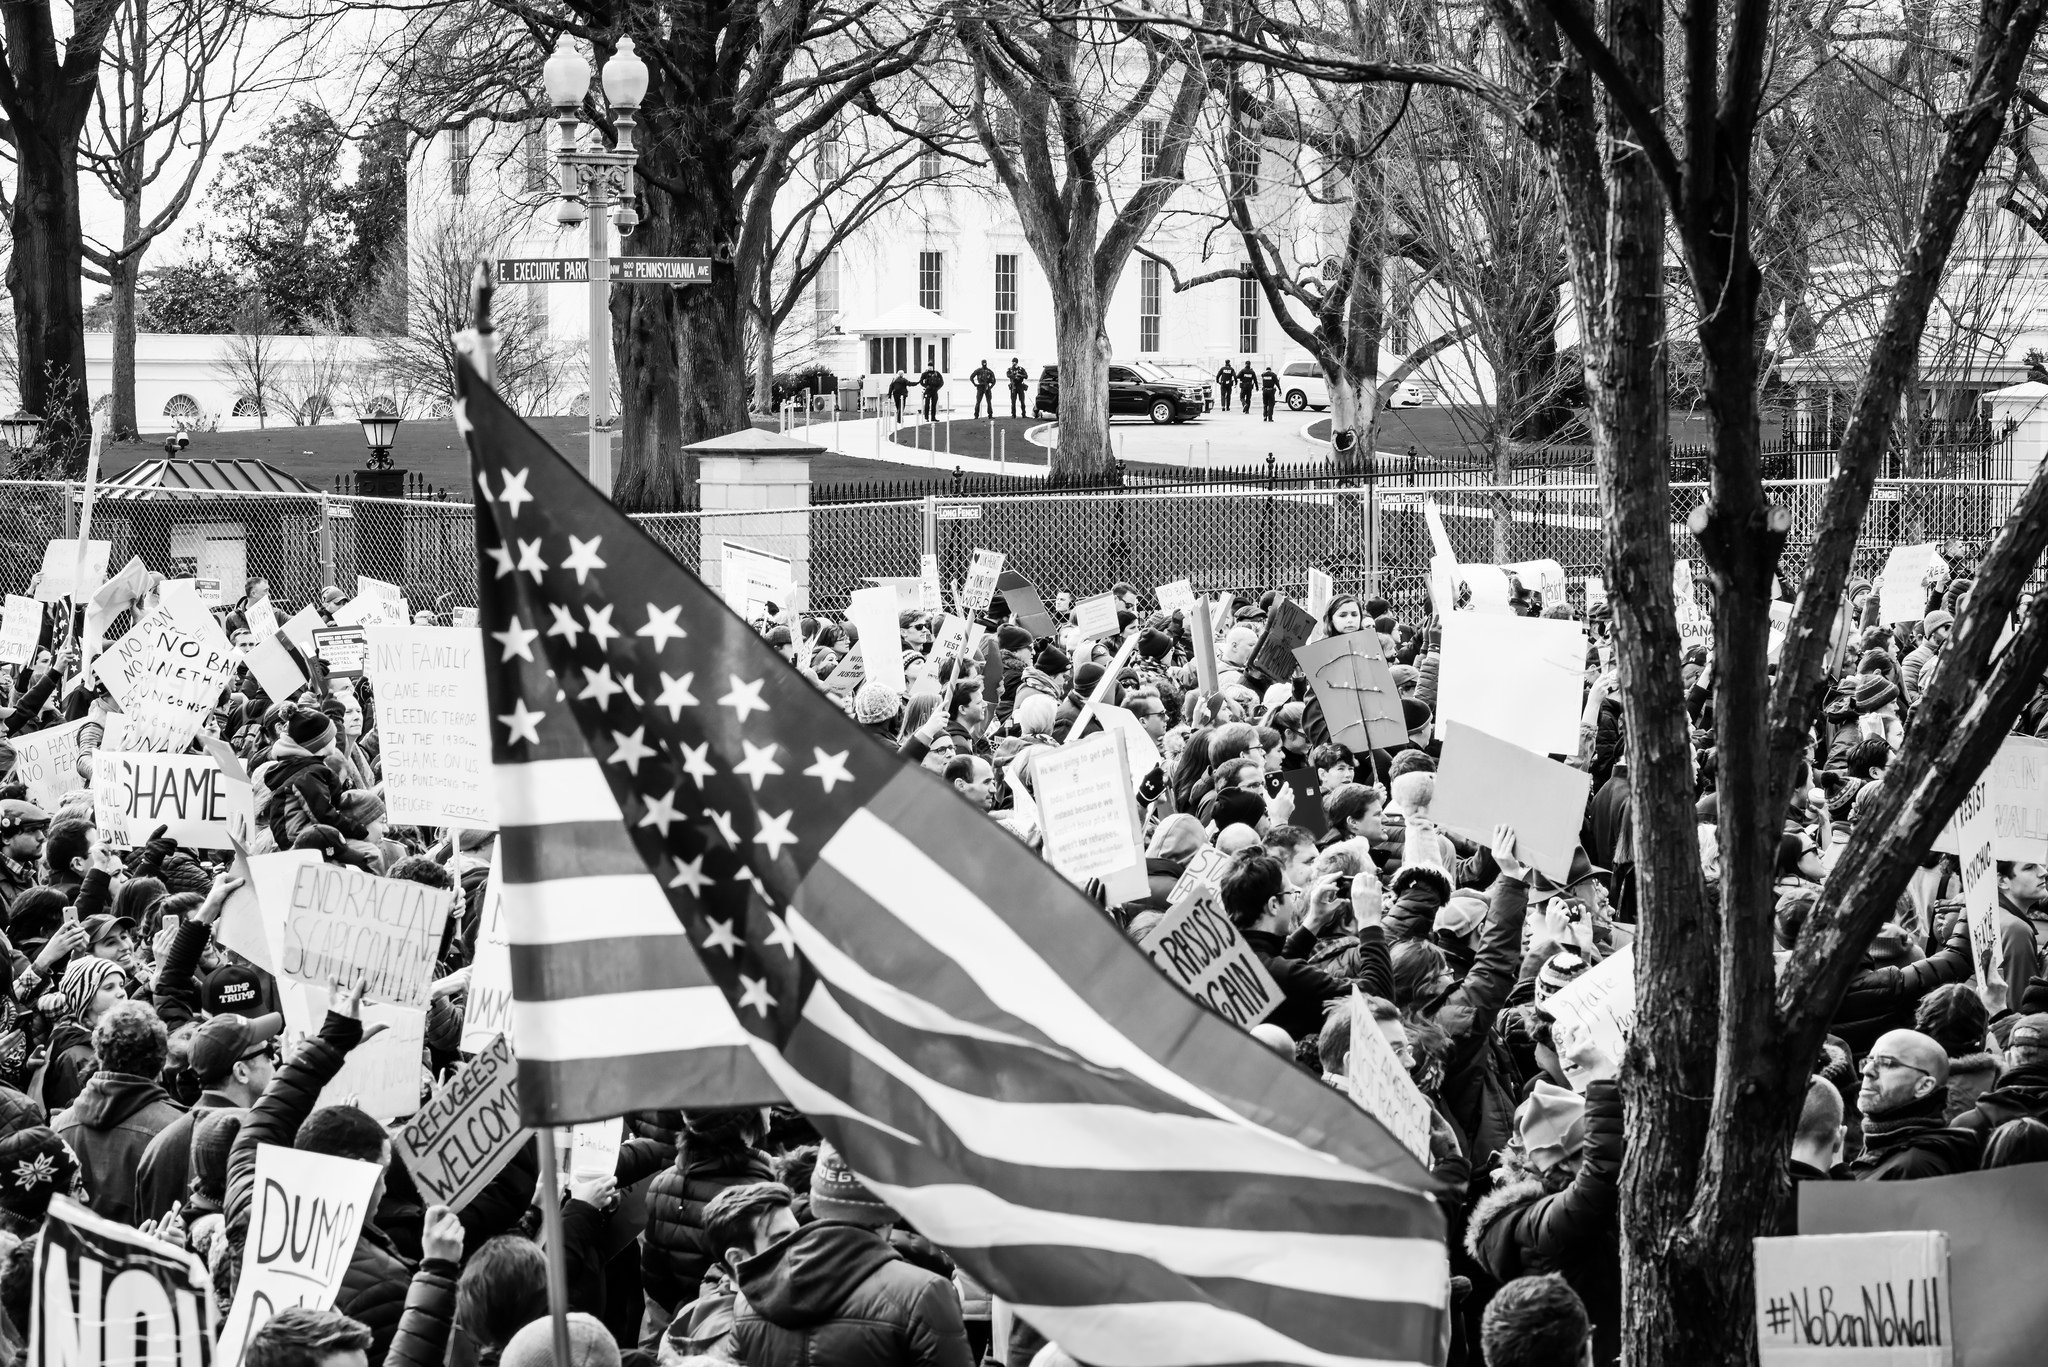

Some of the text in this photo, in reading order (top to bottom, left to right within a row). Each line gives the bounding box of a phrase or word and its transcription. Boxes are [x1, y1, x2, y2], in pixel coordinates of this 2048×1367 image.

[500, 261, 588, 281] E. EXECUTIVE PARK
[622, 261, 635, 269] 1600
[635, 262, 710, 278] PENNSYLVANIA AVE
[1384, 492, 1424, 502] LONG FENCE
[1873, 488, 1897, 500] FENCE
[939, 508, 979, 517] LONG FENCE
[962, 596, 989, 608] WORD
[119, 637, 142, 662] NO
[157, 632, 200, 657] NO
[376, 643, 470, 673] MY FAMILY
[147, 657, 223, 689] UNETHIC
[381, 682, 458, 700] CAME HERE
[386, 707, 478, 726] FLEEING TERROR
[18, 729, 80, 765] NO HATE
[386, 732, 405, 745] IN
[412, 733, 434, 746] THE
[387, 751, 440, 770] SHAME
[444, 752, 461, 769] ON
[1090, 749, 1100, 762] get
[1103, 745, 1114, 758] pho
[22, 752, 78, 782] NO FEA
[123, 760, 227, 822] SHAME
[387, 773, 479, 792] FOR PUNISHING THE
[1096, 781, 1111, 791] here
[392, 795, 433, 812] REFUGEE
[1104, 797, 1113, 806] we
[1959, 780, 1986, 829] RESIST
[113, 812, 121, 825] IS
[114, 829, 130, 846] ALL
[1966, 841, 1992, 895] PSYCHIC
[293, 865, 343, 914] END
[219, 990, 255, 1003] TRUMP
[224, 982, 249, 994] DUMP
[404, 1052, 497, 1158] REFUGEES
[257, 1177, 355, 1272] DUMP
[1766, 1277, 1941, 1347] #NoBanNoWall
